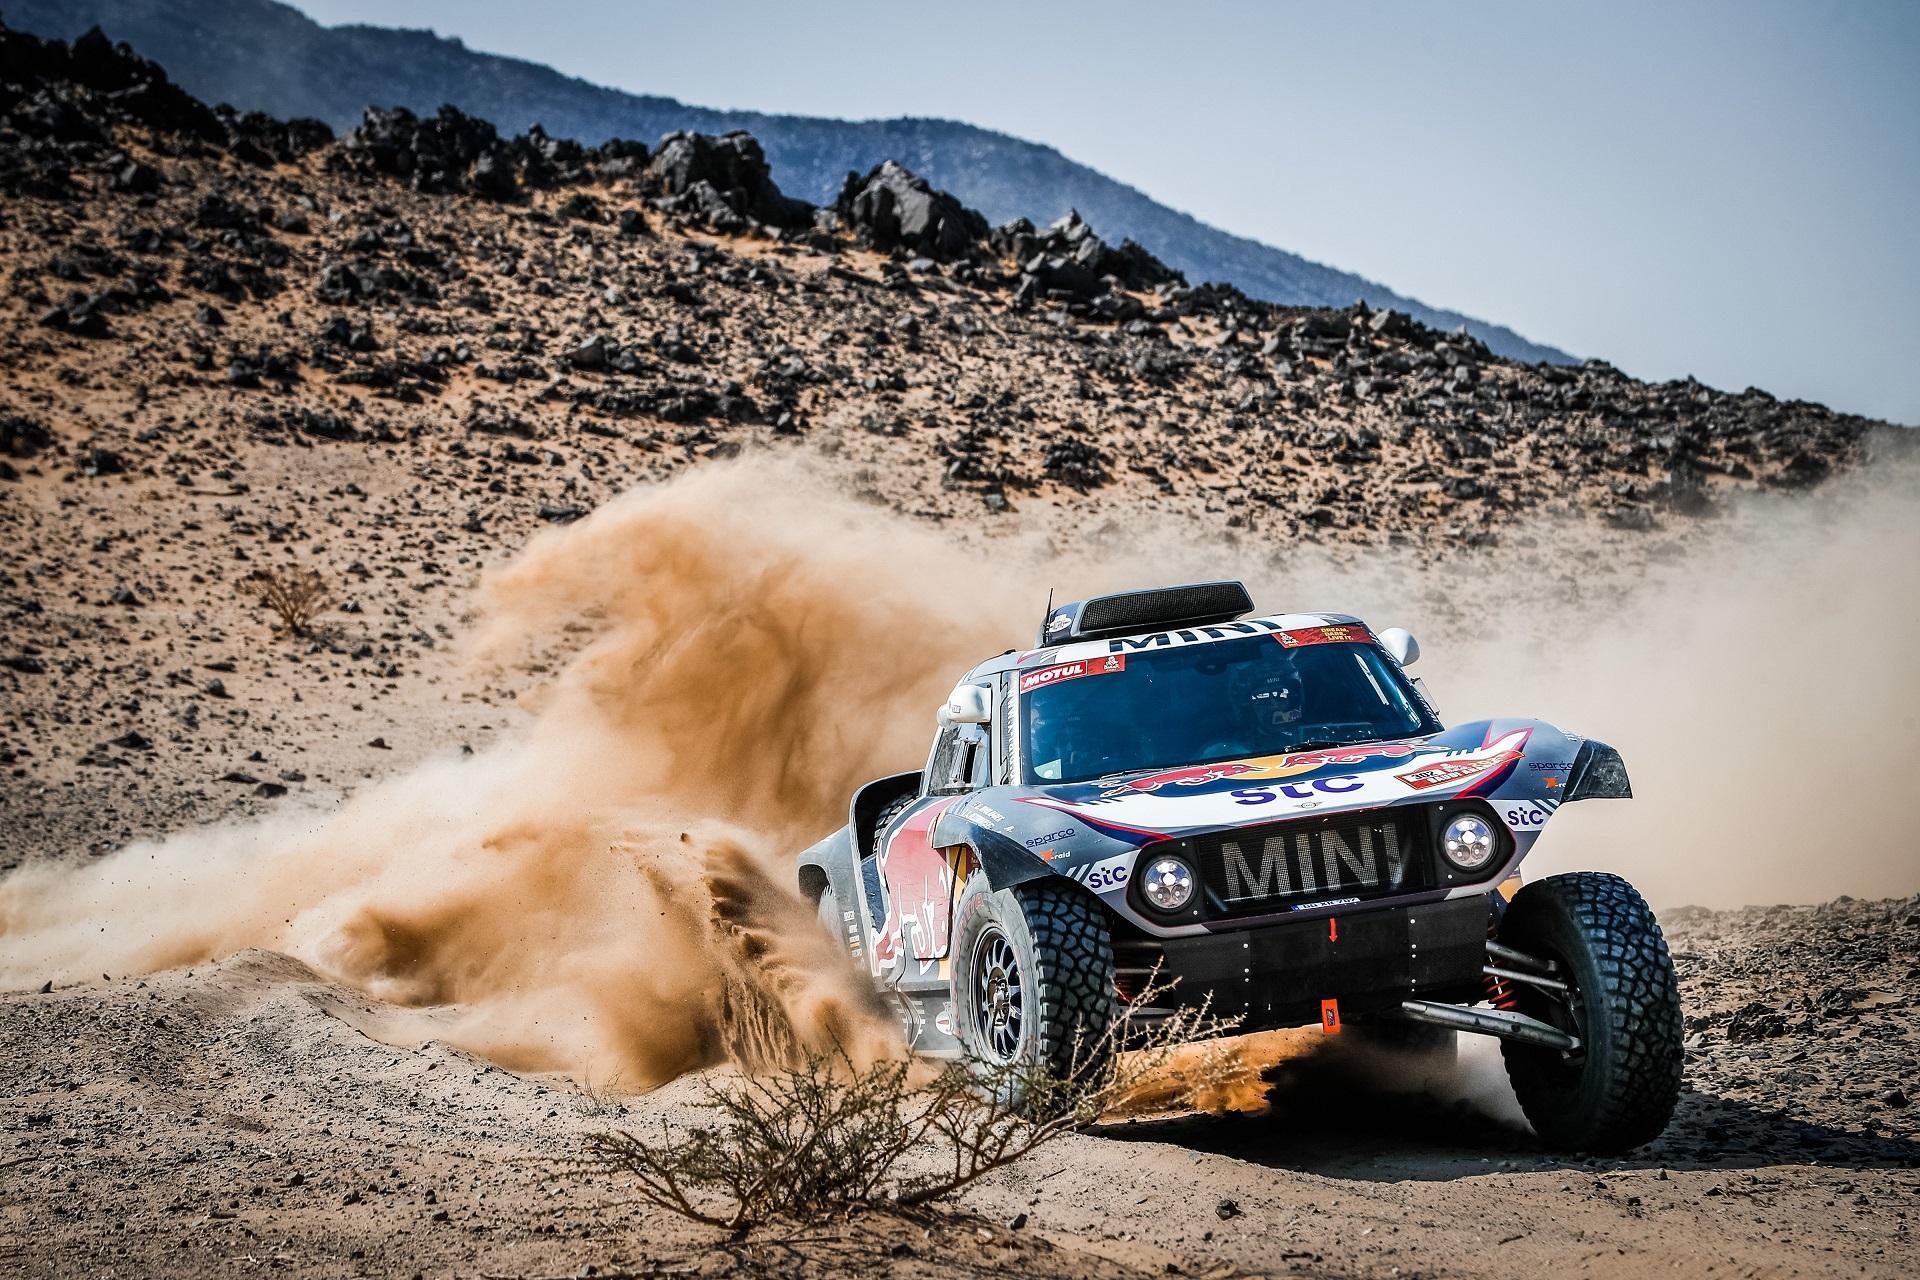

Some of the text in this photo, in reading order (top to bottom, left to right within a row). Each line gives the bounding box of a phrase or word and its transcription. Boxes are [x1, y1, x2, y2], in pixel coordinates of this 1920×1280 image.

[1109, 620, 1282, 652] MINI
[1023, 664, 1084, 688] MOTUL
[1231, 775, 1365, 805] stc
[1507, 807, 1544, 826] stc
[1025, 828, 1076, 849] sparco
[1222, 823, 1403, 902] MINI
[1088, 866, 1128, 889] stc
